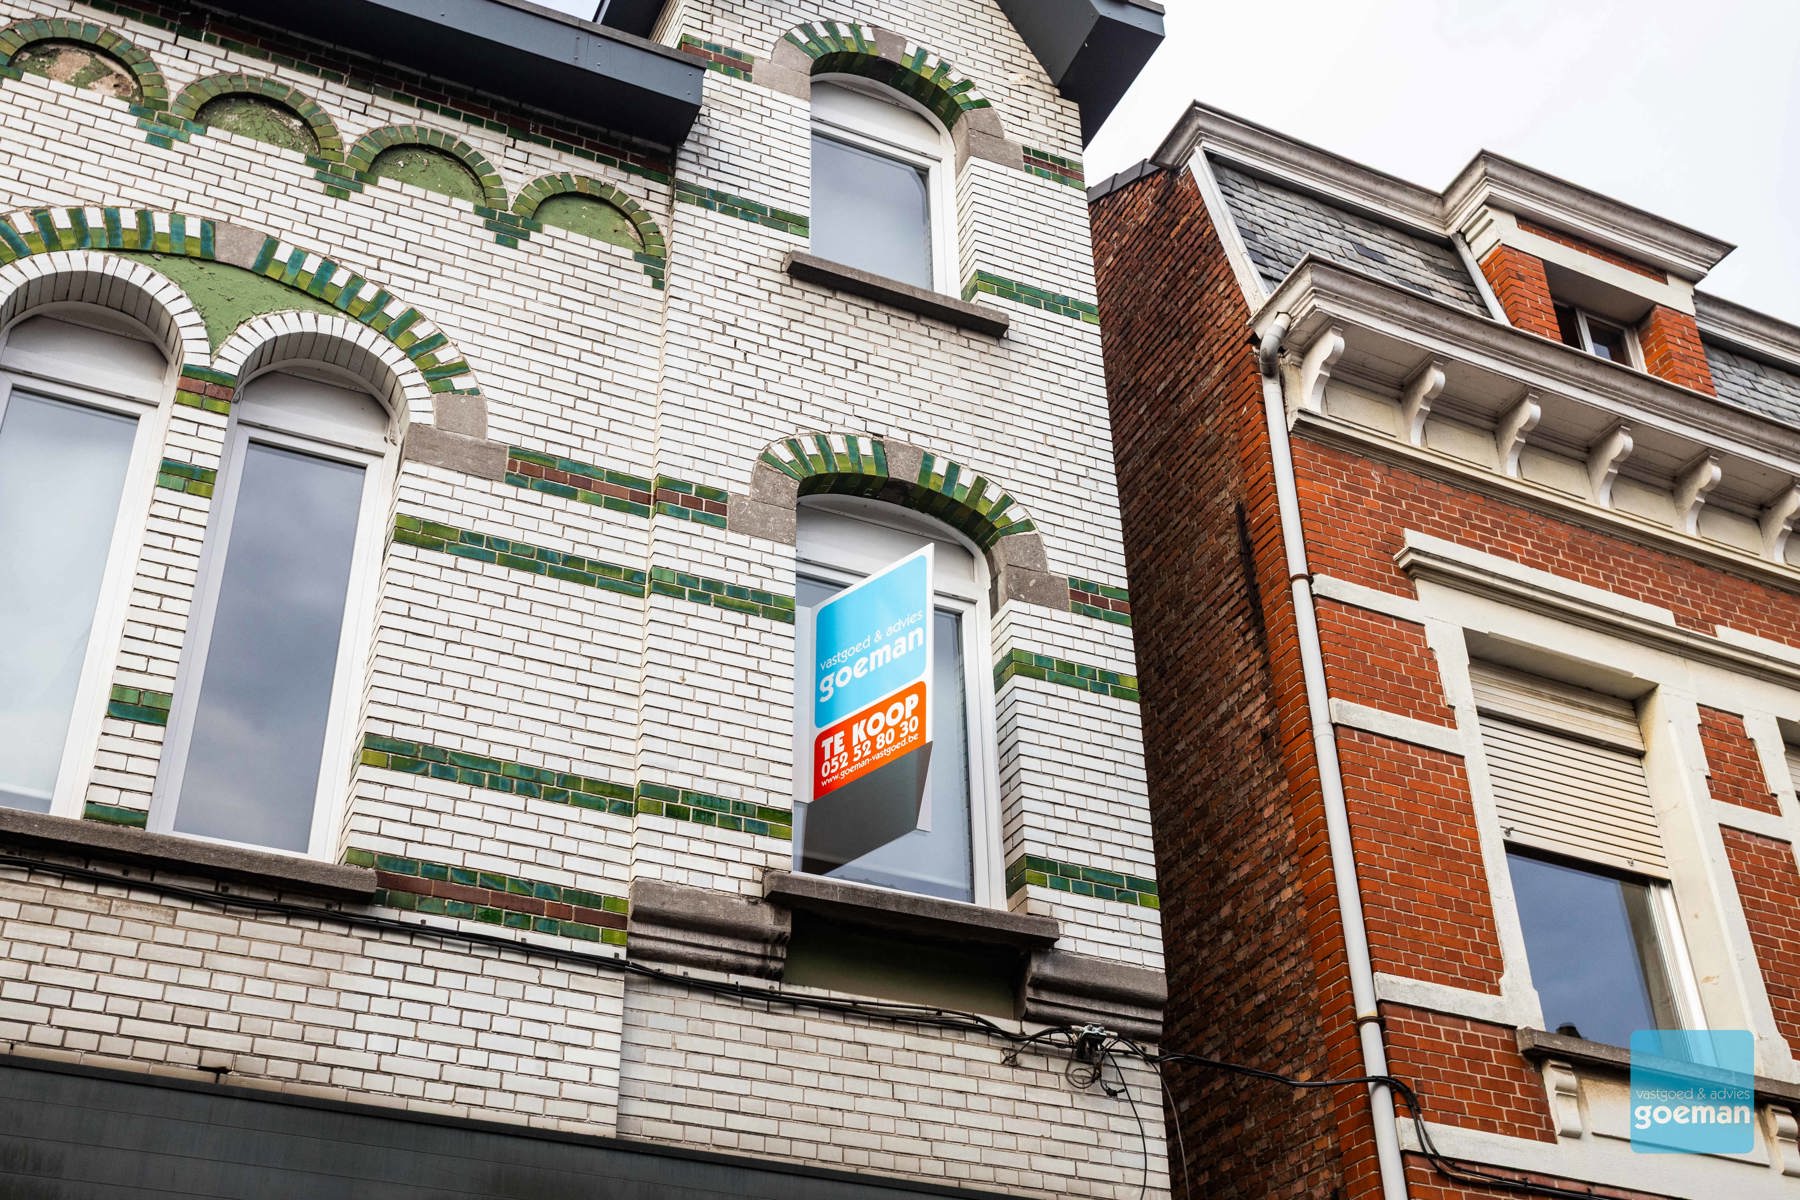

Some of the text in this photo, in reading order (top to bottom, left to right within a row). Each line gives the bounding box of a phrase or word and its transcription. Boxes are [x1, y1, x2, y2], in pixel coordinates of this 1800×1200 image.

[819, 627, 924, 703] goeman
[821, 609, 923, 671] vastgoed & advies
[821, 694, 919, 760] TE KOOP
[821, 716, 919, 778] 052 52 80 30
[821, 733, 919, 787] www.goeman-vastgoed.be
